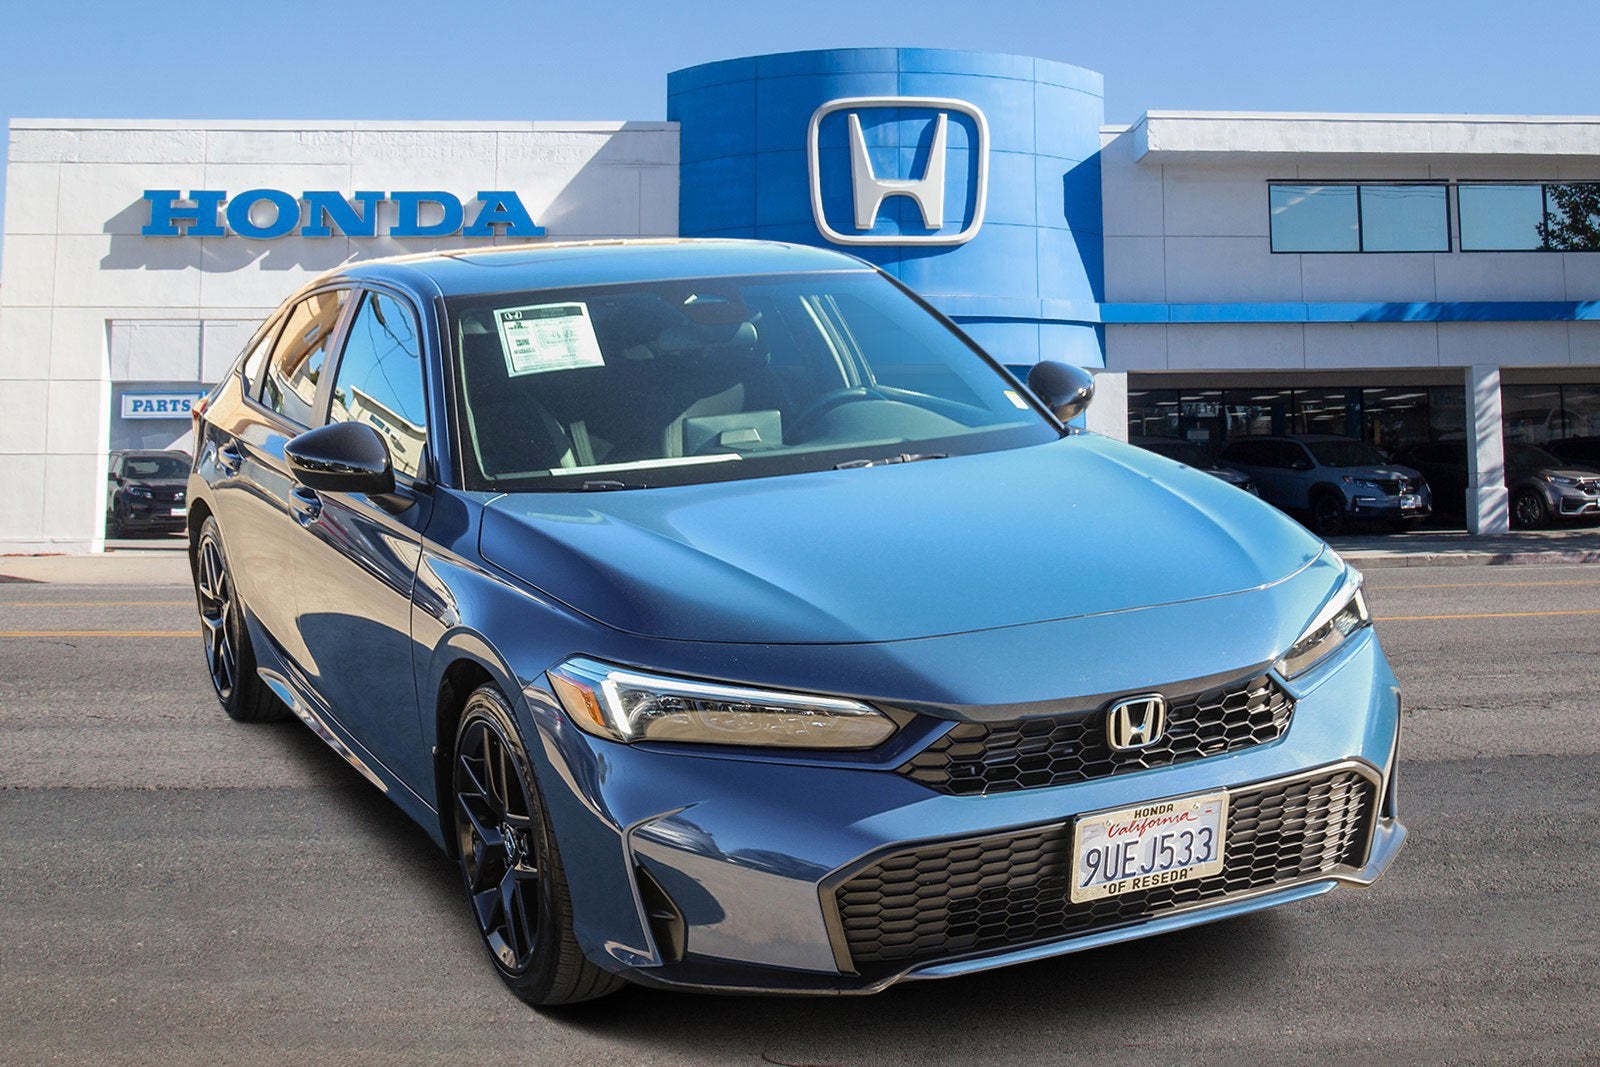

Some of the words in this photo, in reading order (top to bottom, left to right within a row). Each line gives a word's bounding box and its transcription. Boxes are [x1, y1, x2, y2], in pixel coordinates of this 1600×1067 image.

[141, 188, 547, 240] HONDA
[131, 399, 192, 412] PARTS
[1133, 803, 1175, 819] HONDA
[1107, 811, 1199, 838] California
[1081, 826, 1214, 887] 9UEJ533
[1108, 883, 1127, 895] OF
[1132, 870, 1189, 890] RESEDA
